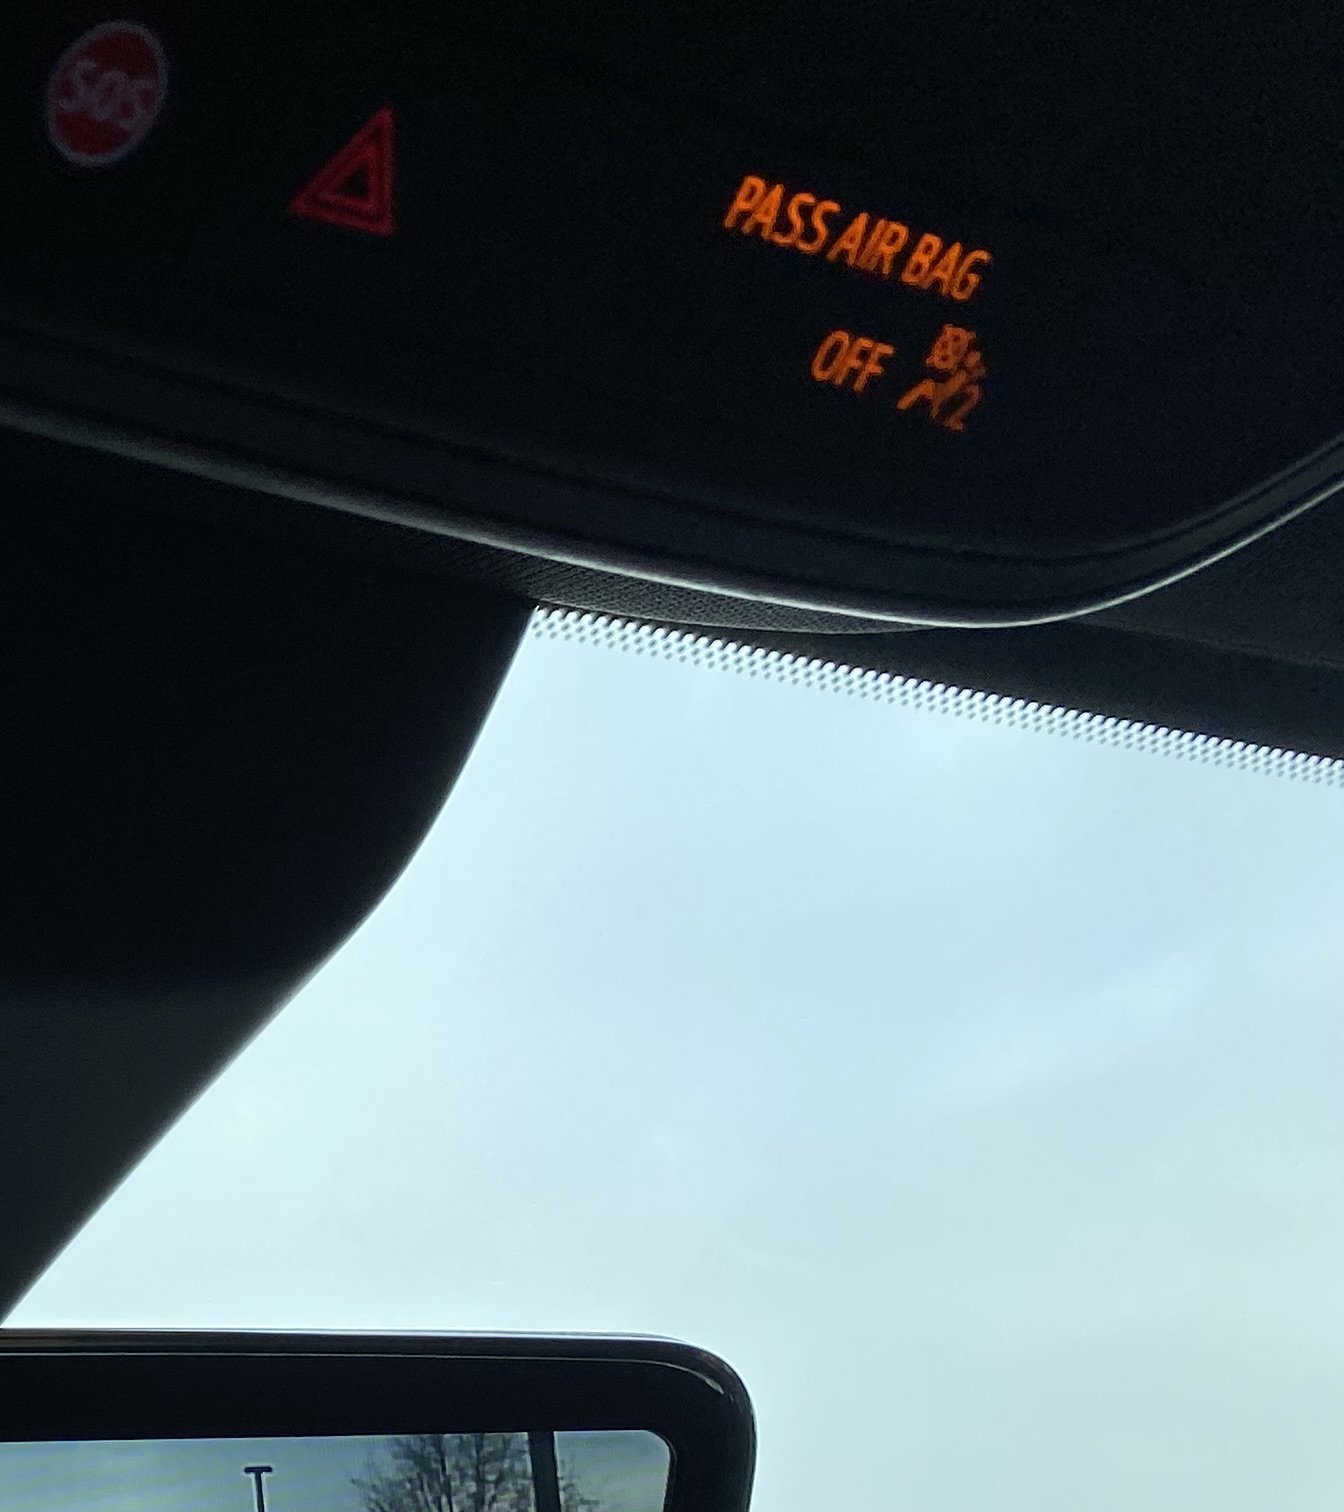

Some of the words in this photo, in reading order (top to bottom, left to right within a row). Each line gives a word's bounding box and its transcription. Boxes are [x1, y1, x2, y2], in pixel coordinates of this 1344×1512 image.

[57, 57, 153, 130] SOS
[723, 174, 841, 253] PASS
[826, 212, 909, 275] AIR
[900, 233, 992, 300] BAG
[812, 329, 895, 392] OFF
